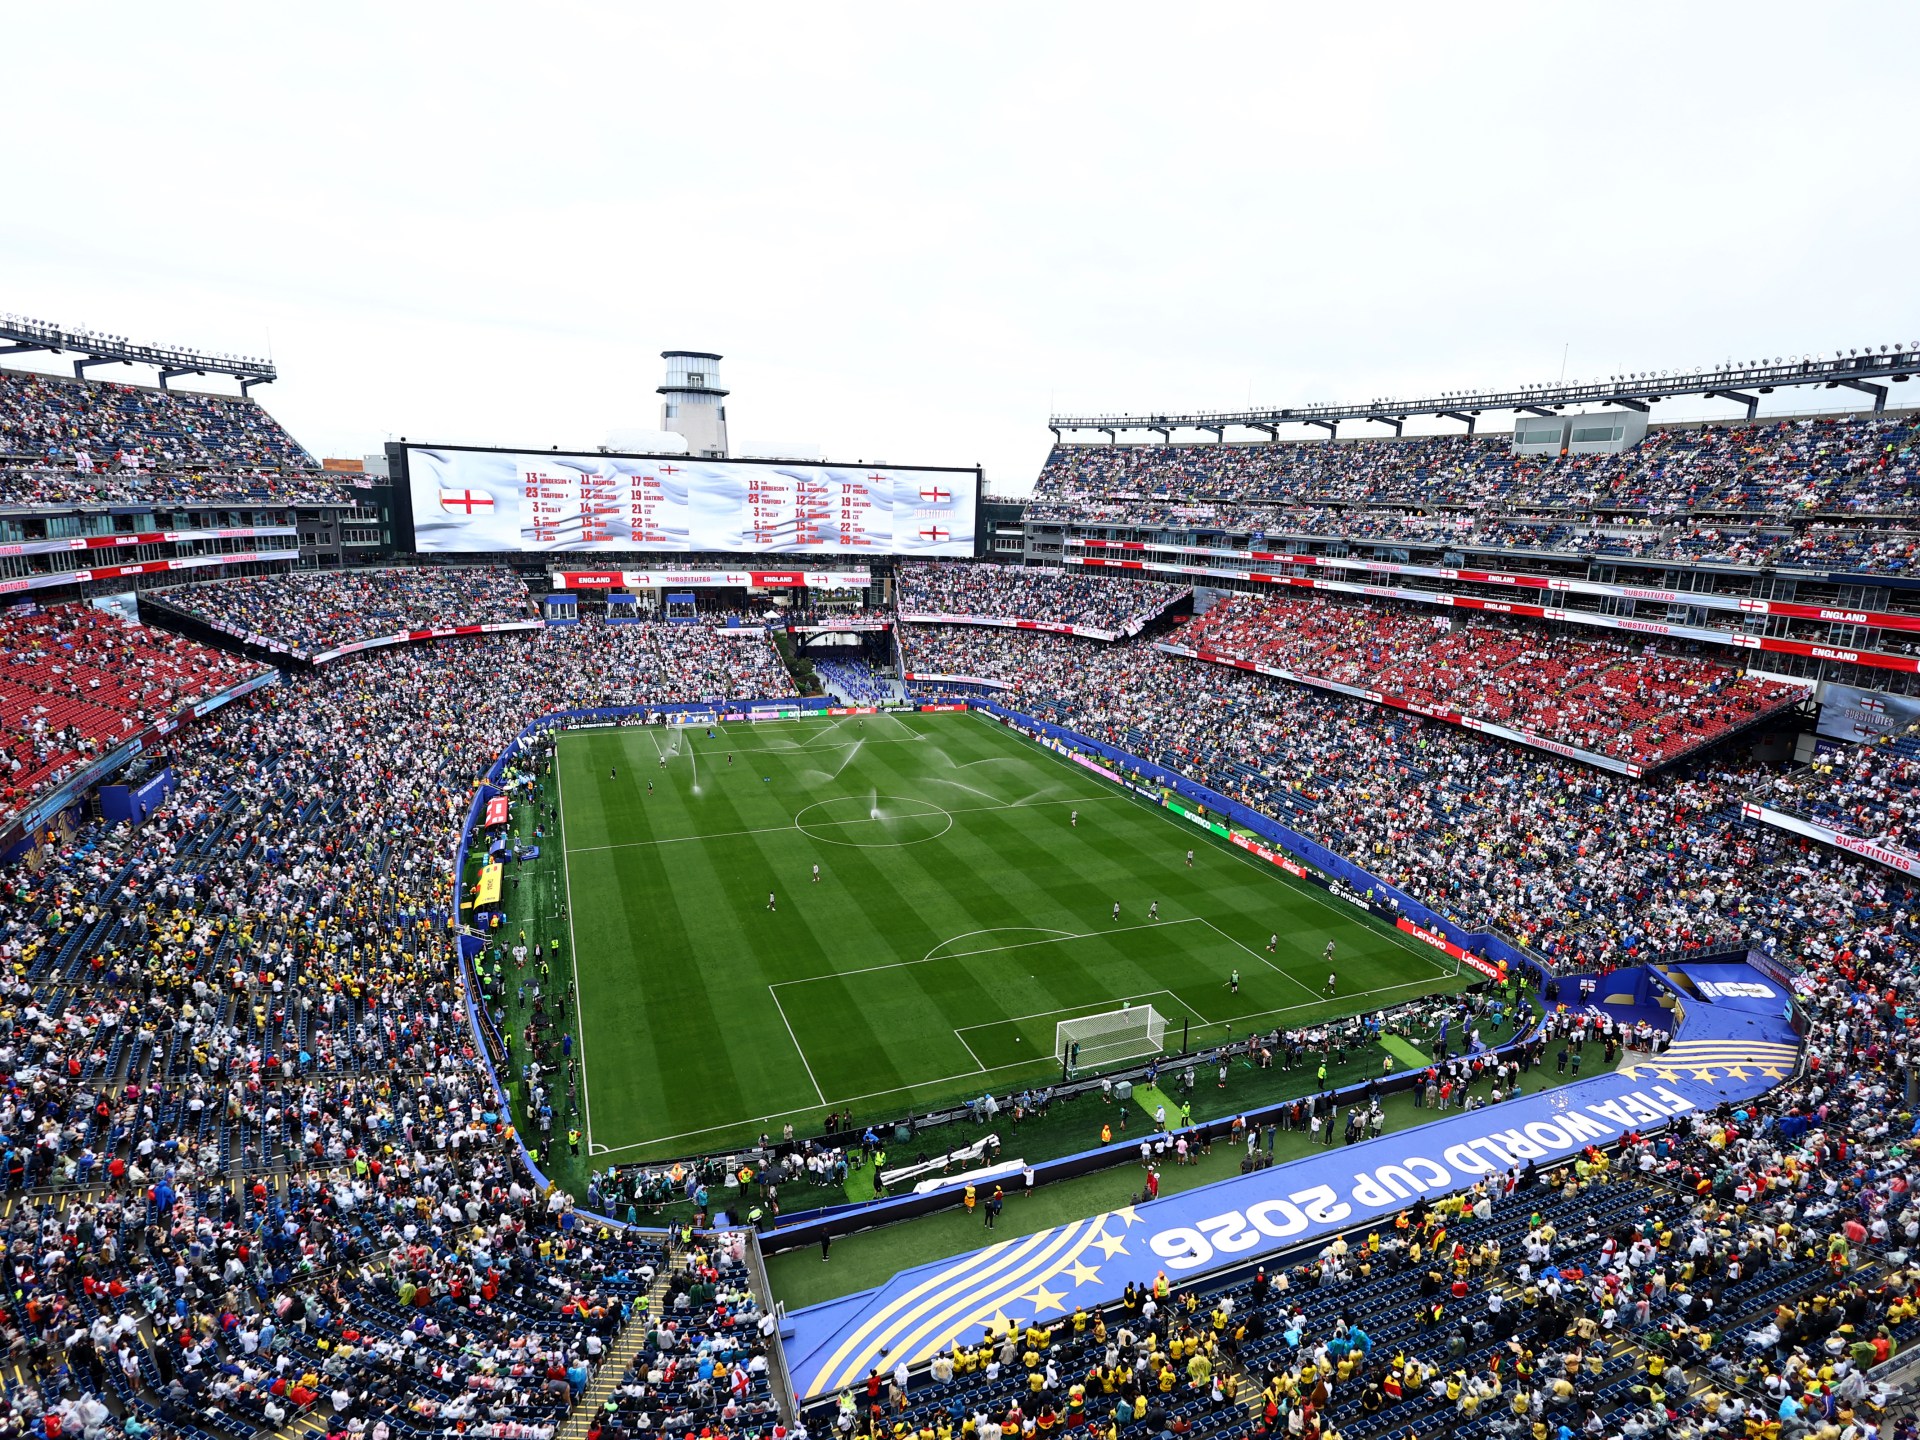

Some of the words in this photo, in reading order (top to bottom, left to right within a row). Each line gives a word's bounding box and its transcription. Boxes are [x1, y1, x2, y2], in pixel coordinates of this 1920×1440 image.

[526, 472, 538, 484] 13
[581, 474, 590, 485] 11
[631, 476, 641, 486] 17
[749, 480, 759, 490] 13
[797, 482, 806, 492] 11
[842, 484, 851, 494] 17
[526, 487, 538, 498] 23
[580, 489, 591, 499] 12
[631, 490, 642, 500] 19
[748, 494, 759, 504] 23
[796, 496, 806, 505] 12
[842, 497, 850, 506] 19
[532, 502, 538, 512] 3
[580, 503, 591, 514] 14
[632, 504, 642, 514] 21
[754, 507, 760, 516] 3
[796, 508, 805, 518] 14
[842, 510, 850, 520] 21
[534, 516, 540, 527] 5
[580, 516, 592, 528] 15
[632, 518, 642, 528] 22
[754, 520, 760, 530] 5
[796, 522, 806, 531] 15
[840, 522, 850, 532] 22
[534, 530, 540, 541] 7
[582, 530, 593, 542] 16
[632, 530, 643, 542] 26
[754, 533, 760, 543] 7
[796, 534, 806, 544] 16
[840, 534, 850, 544] 26
[222, 554, 257, 562] SUBSTITUTES
[120, 566, 143, 574] ENGLAND
[1366, 564, 1400, 572] SUBSTITUTES
[1488, 574, 1516, 584] ENGLAND
[1363, 588, 1397, 596] SUBSTITUTES
[1623, 588, 1676, 600] SUBSTITUTES
[1484, 602, 1511, 612] ENGLAND
[1820, 610, 1868, 623] ENGLAND
[432, 628, 456, 636] ENGLAND
[1618, 620, 1669, 634] SUBSTITUTES
[1216, 656, 1236, 664] ENGLAND
[1811, 648, 1858, 662] ENGLAND
[1408, 703, 1434, 716] ENGLAND
[1844, 709, 1895, 727] SUBSTITUTES
[1526, 736, 1574, 756] SUBSTITUTES
[1184, 809, 1212, 830] aramco
[1836, 835, 1910, 870] SUSTITUTES
[1282, 860, 1300, 876] Coca-Cola
[1376, 883, 1387, 895] FIFA
[1340, 890, 1370, 911] HYUNDAI
[1412, 926, 1446, 950] Lenovo
[1462, 951, 1498, 978] Lenovo
[1586, 1085, 1696, 1128] FIFA
[1444, 1111, 1616, 1174] WORLD
[1352, 1157, 1452, 1208] CUP
[1150, 1184, 1352, 1270] 2026
